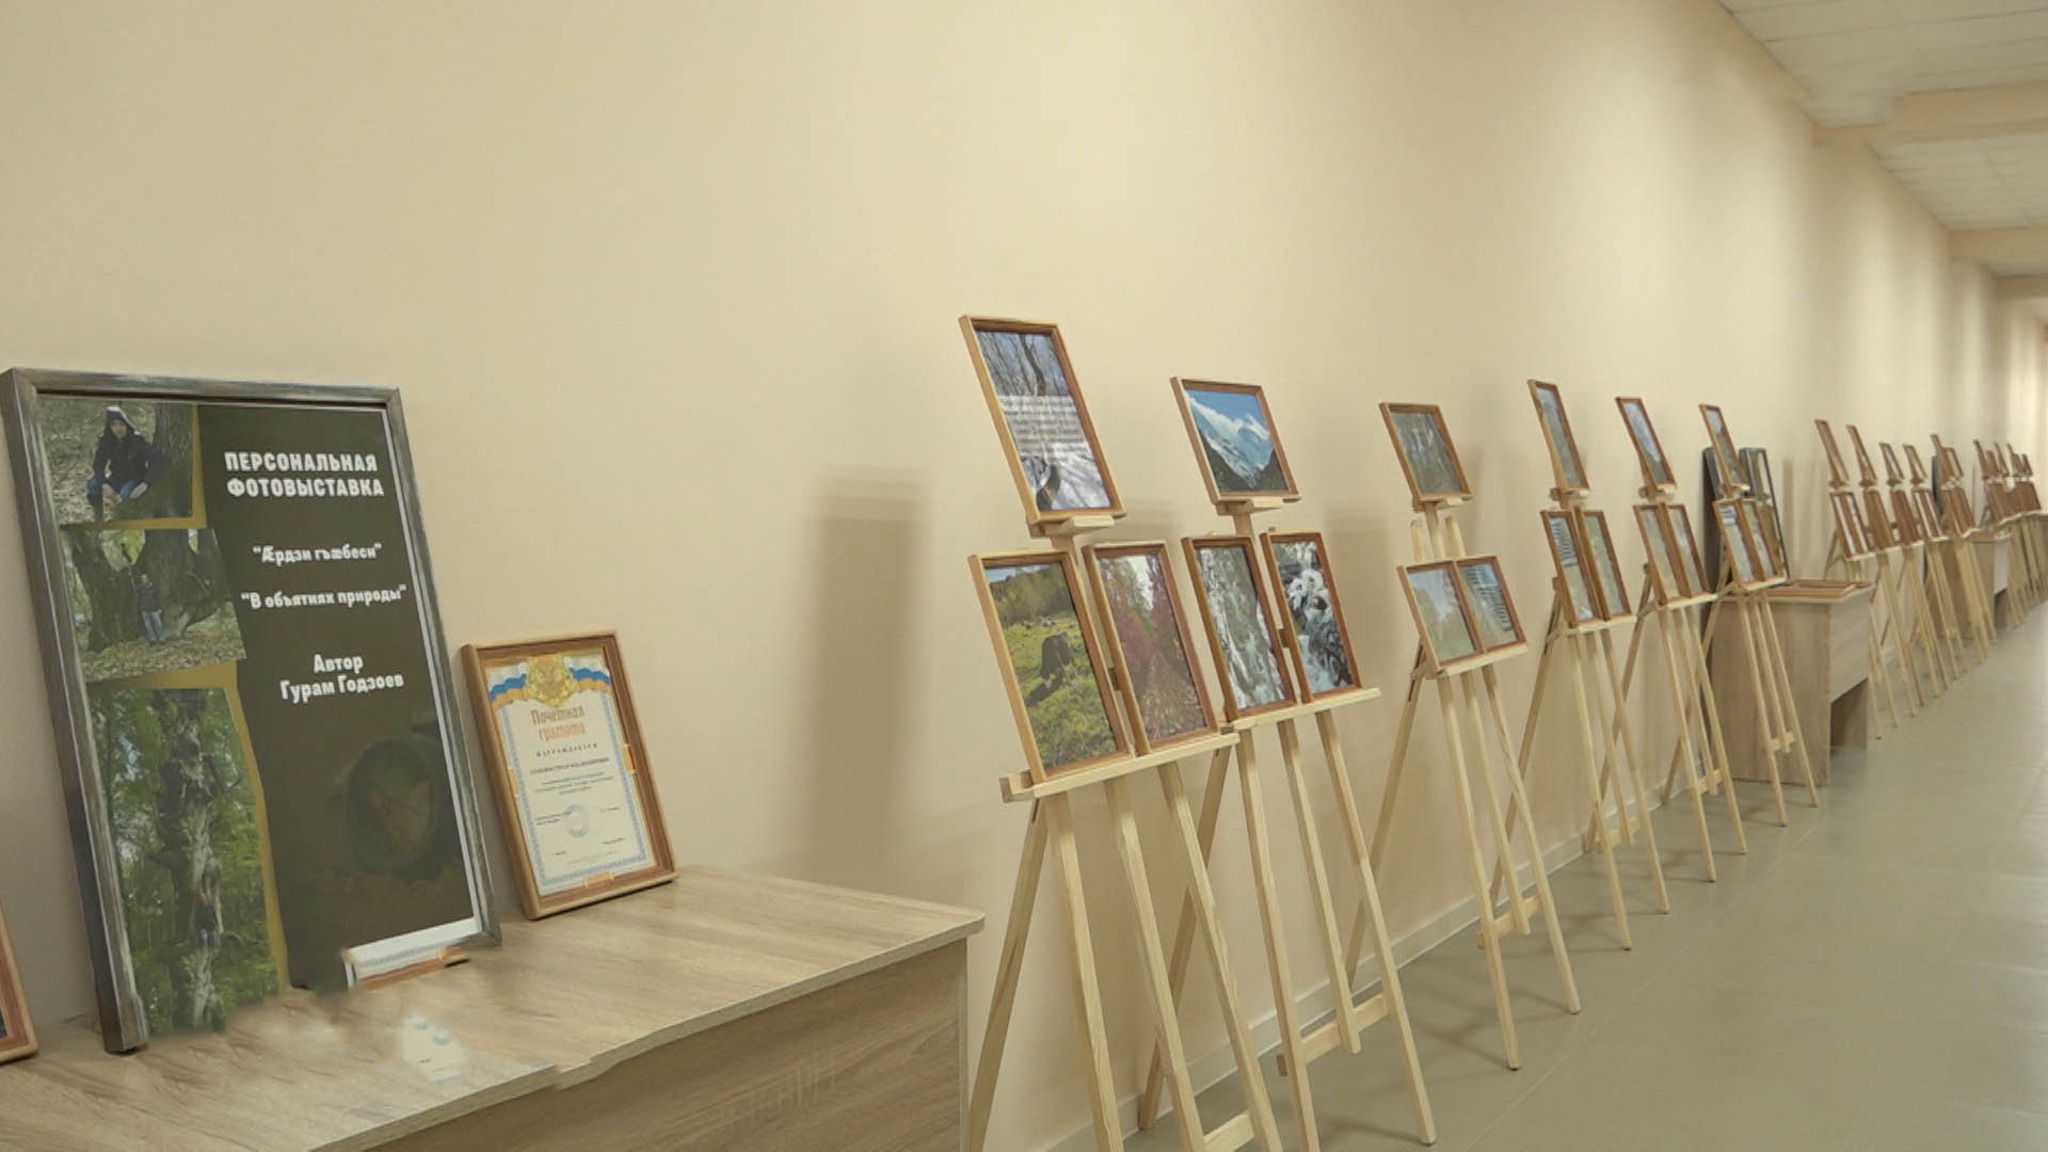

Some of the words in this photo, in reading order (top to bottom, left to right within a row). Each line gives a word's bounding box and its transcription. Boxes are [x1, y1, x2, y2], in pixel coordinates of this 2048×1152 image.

[224, 451, 378, 472] ПЕРСОНАЛЬНАЯ
[226, 477, 385, 497] ФОТОВЫСТАВКА
[240, 591, 262, 609] "В
[264, 590, 336, 609] объятиях
[337, 584, 407, 608] природы"
[313, 653, 364, 674] Автор
[279, 678, 336, 704] Гурам
[337, 673, 404, 695] Годзоев
